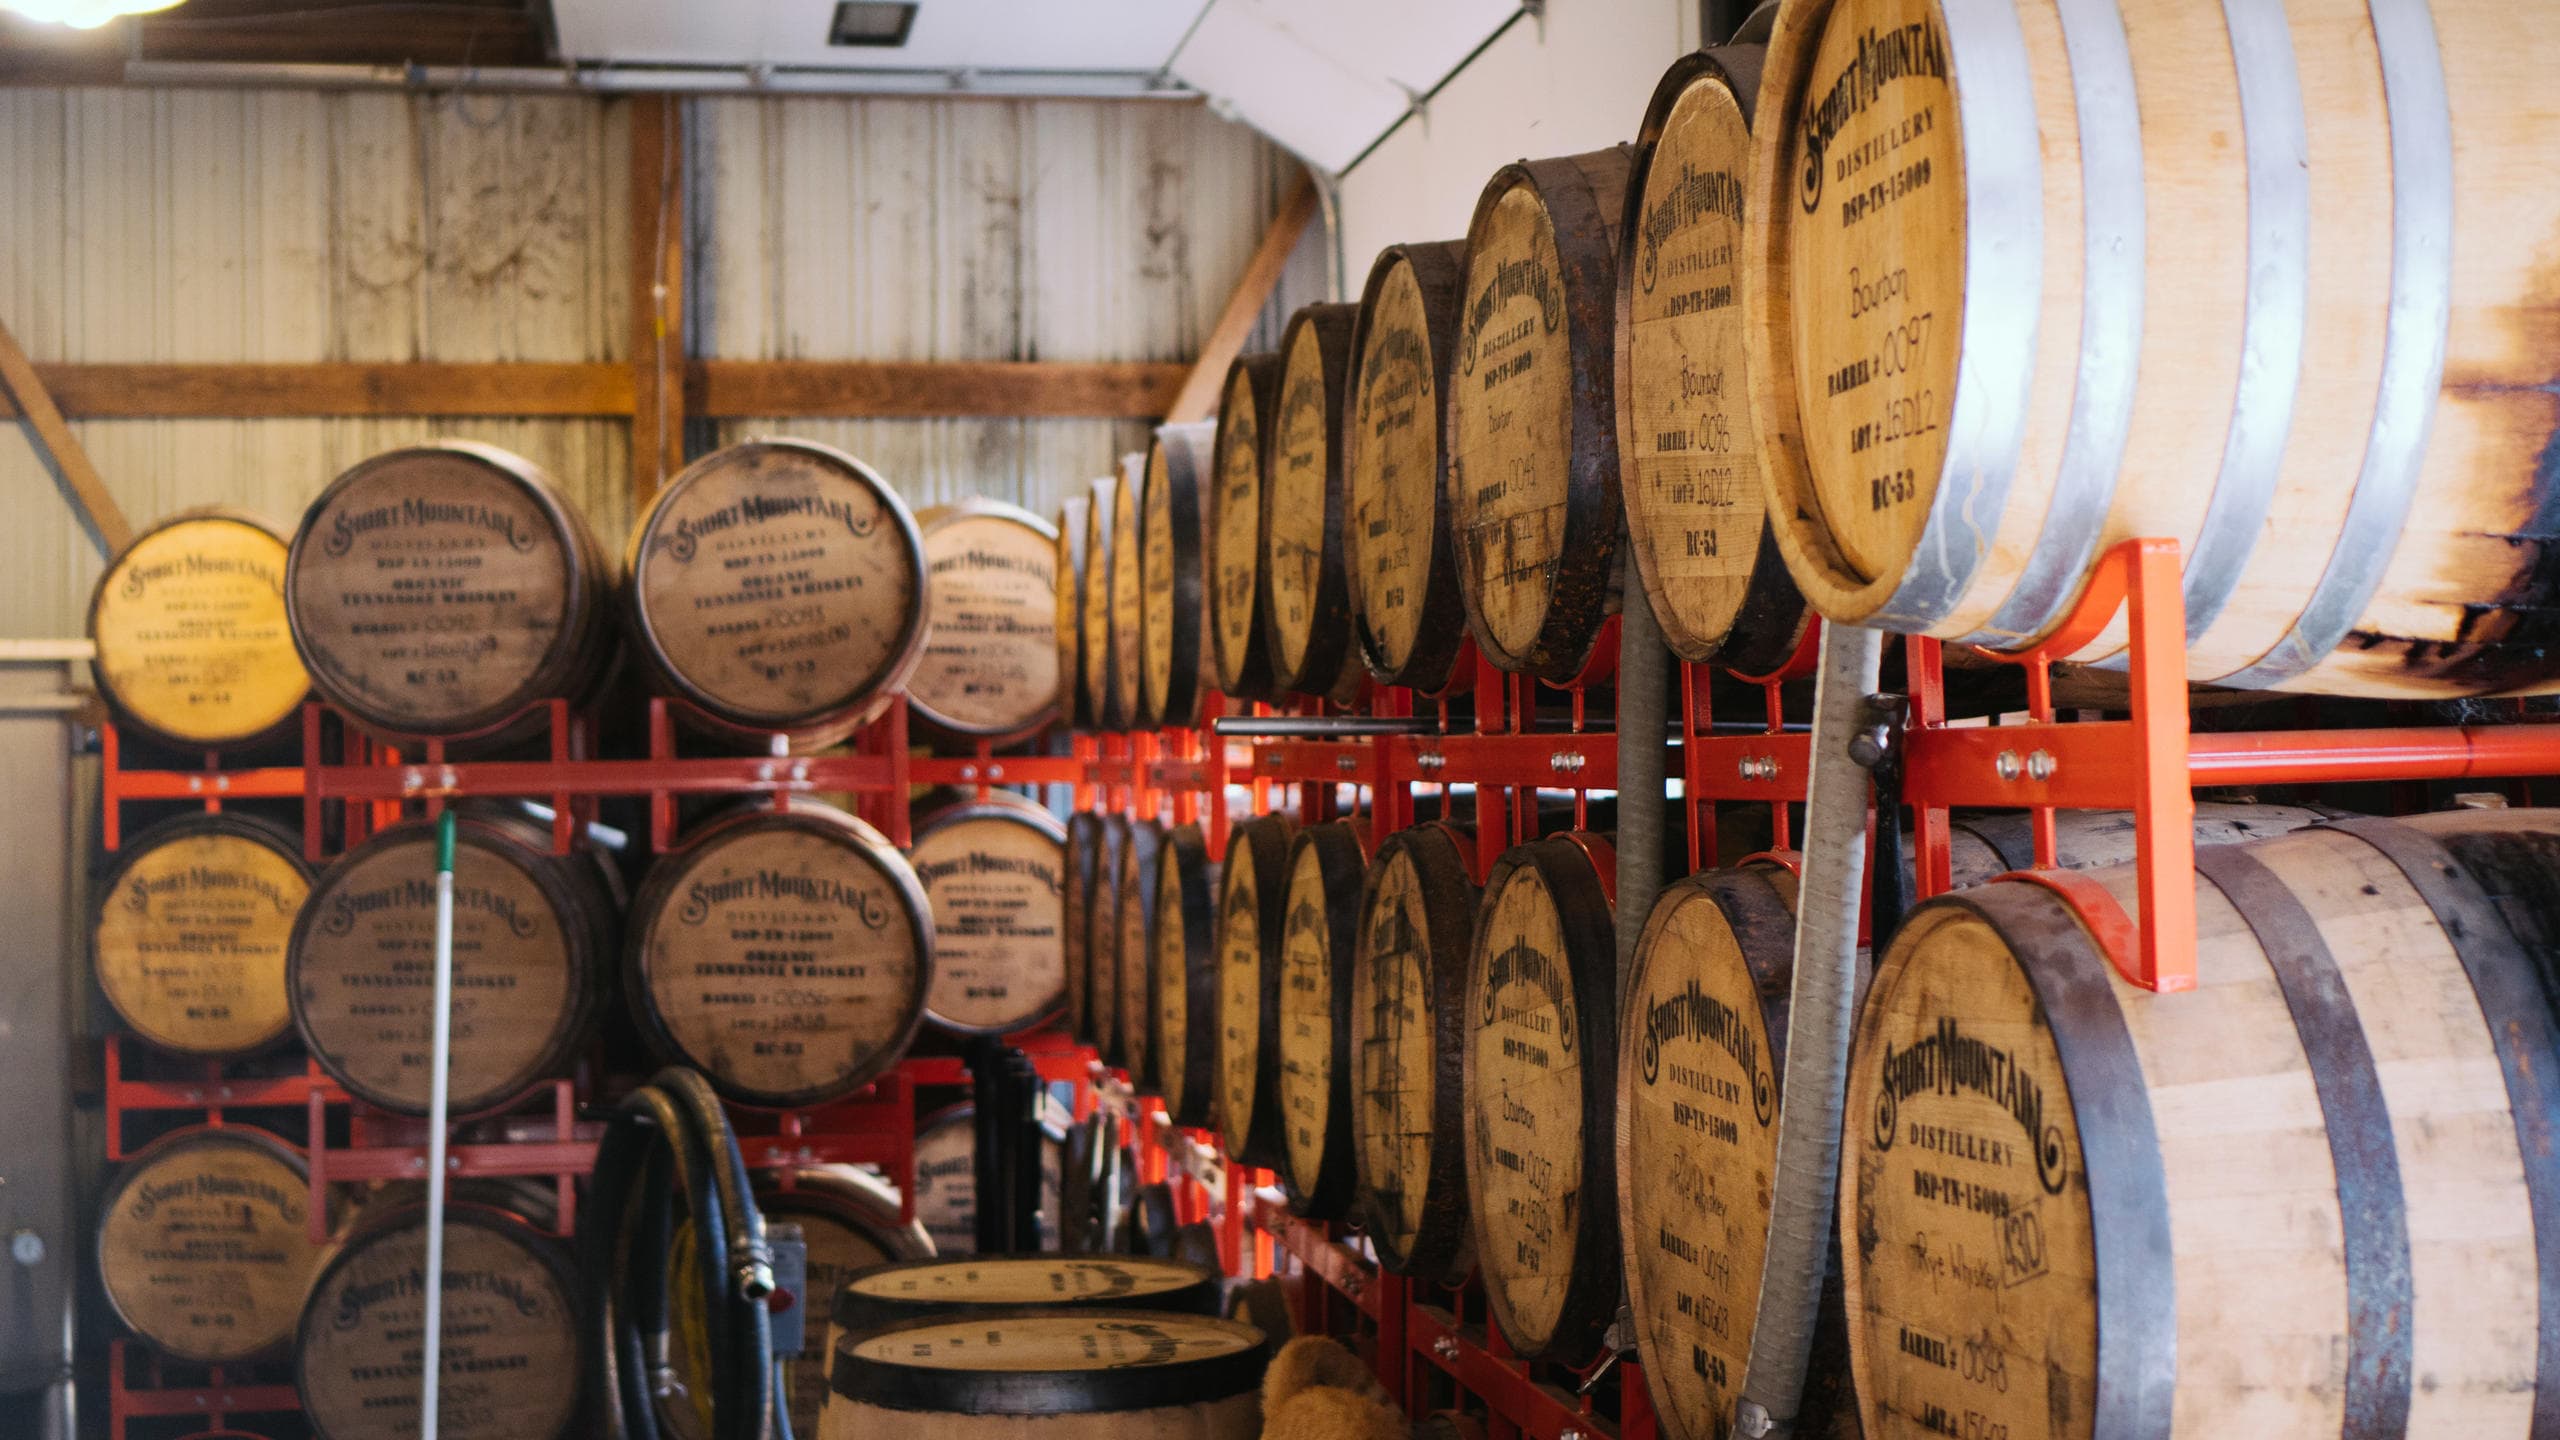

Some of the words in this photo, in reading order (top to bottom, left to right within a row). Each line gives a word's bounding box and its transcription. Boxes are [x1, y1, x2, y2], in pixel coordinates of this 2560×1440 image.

[1836, 106, 1934, 182] DISTILLERY
[1666, 243, 1734, 279] DISTILLERY
[1670, 285, 1732, 318] DSP-TN-15009
[1482, 316, 1536, 359] DISTILLERY
[1828, 359, 1870, 398] BARREL
[1883, 312, 1933, 378] 0097
[1681, 354, 1725, 400] Bourbon
[1657, 430, 1687, 453] BARREL
[1698, 413, 1731, 454] 0096
[1851, 423, 1871, 454] LOT
[1686, 528, 1718, 557] RC-53
[1501, 1004, 1552, 1035] DISTILLERY
[1642, 992, 1686, 1086] SHORT
[1669, 1063, 1741, 1105] DISTILLERY
[1874, 1035, 1937, 1153] SHORT
[1936, 1016, 2068, 1196] MOUNTAIN
[1673, 1101, 1738, 1146] DSP-TN-15009
[1910, 1122, 2015, 1168] DISTILLERY
[1913, 1169, 2010, 1219] DSP-TN-15009
[1660, 1227, 1692, 1264] BARREL
[1701, 1244, 1730, 1293] 0049
[1913, 1231, 1945, 1295] Rye
[1948, 1242, 2000, 1314] Whiskey
[1900, 1326, 1947, 1368] BARREL
[1924, 1401, 1947, 1434] LOT
